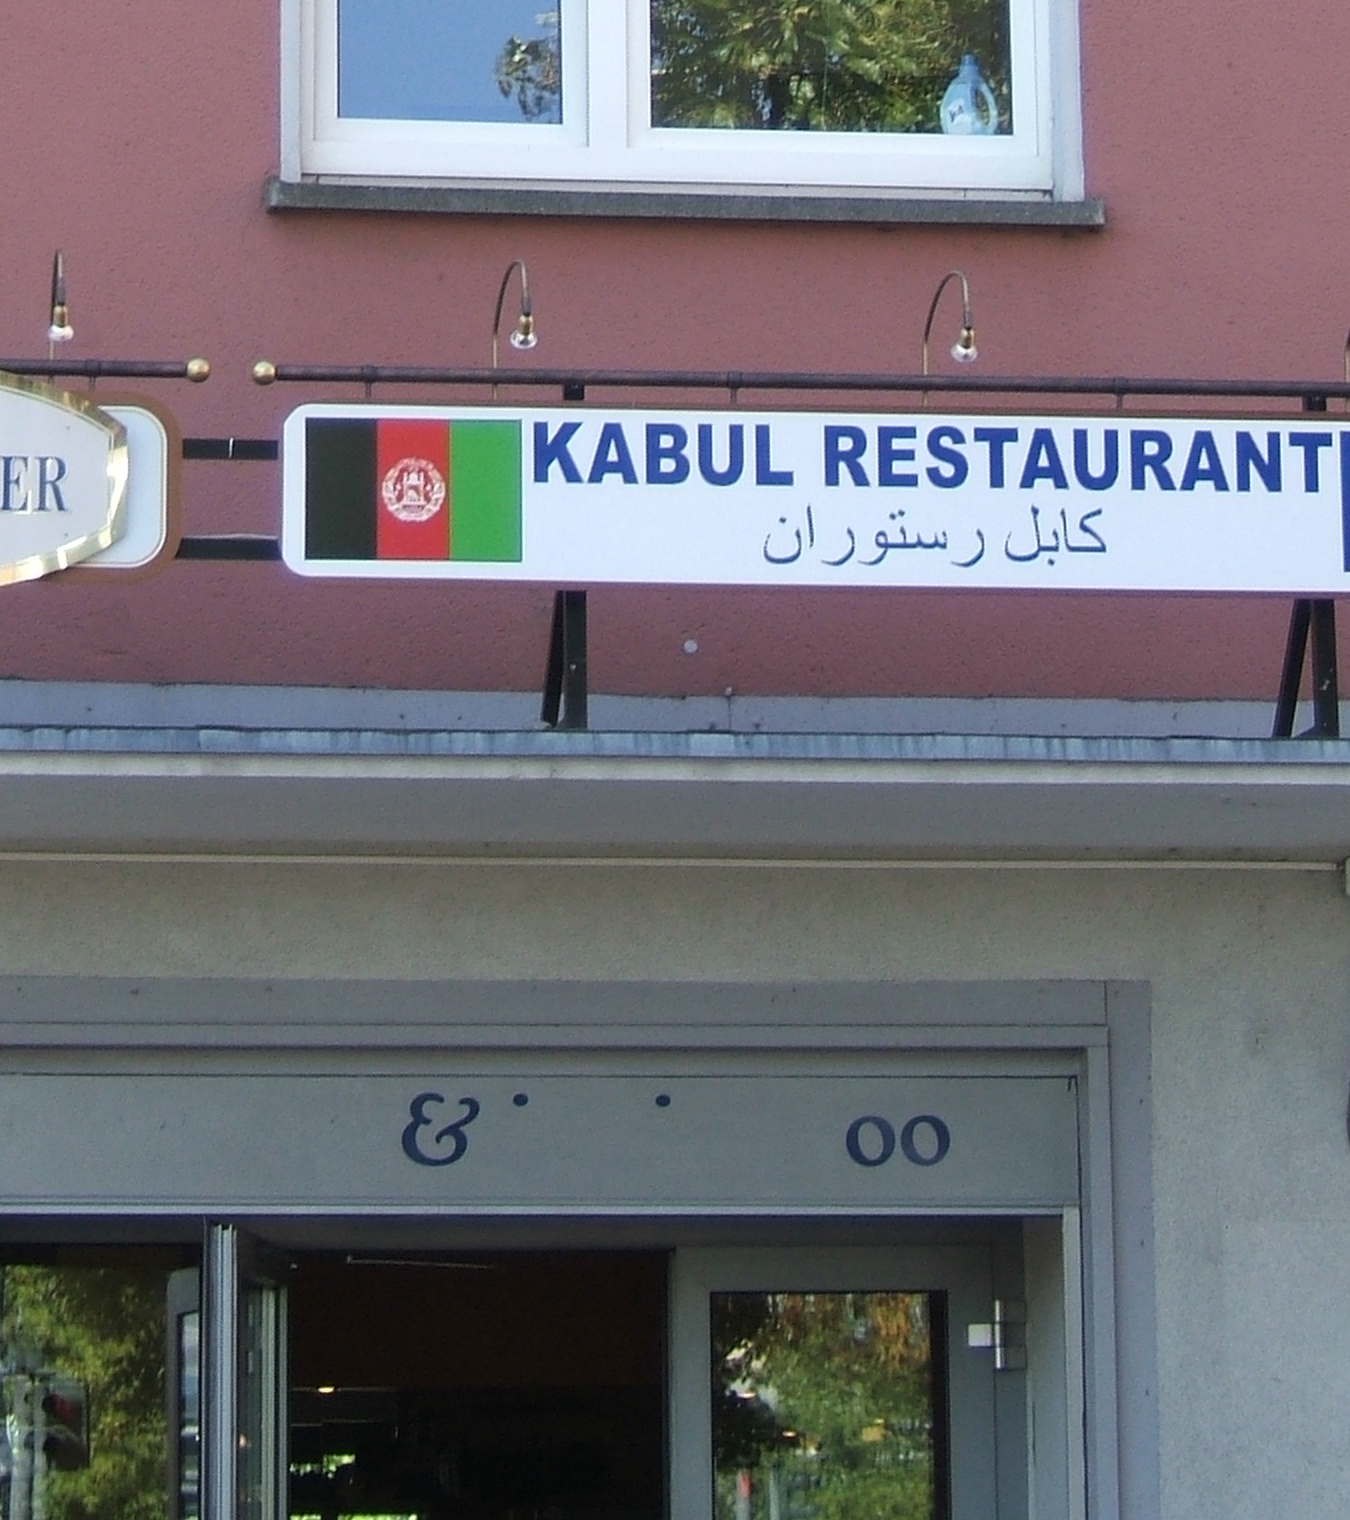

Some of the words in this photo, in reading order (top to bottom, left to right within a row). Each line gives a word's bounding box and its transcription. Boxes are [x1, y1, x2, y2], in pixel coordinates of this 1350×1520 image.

[533, 421, 795, 487] KABUL
[823, 425, 1334, 493] RESTAURANT
[762, 502, 986, 568] رستوران
[1004, 503, 1108, 567] كابل
